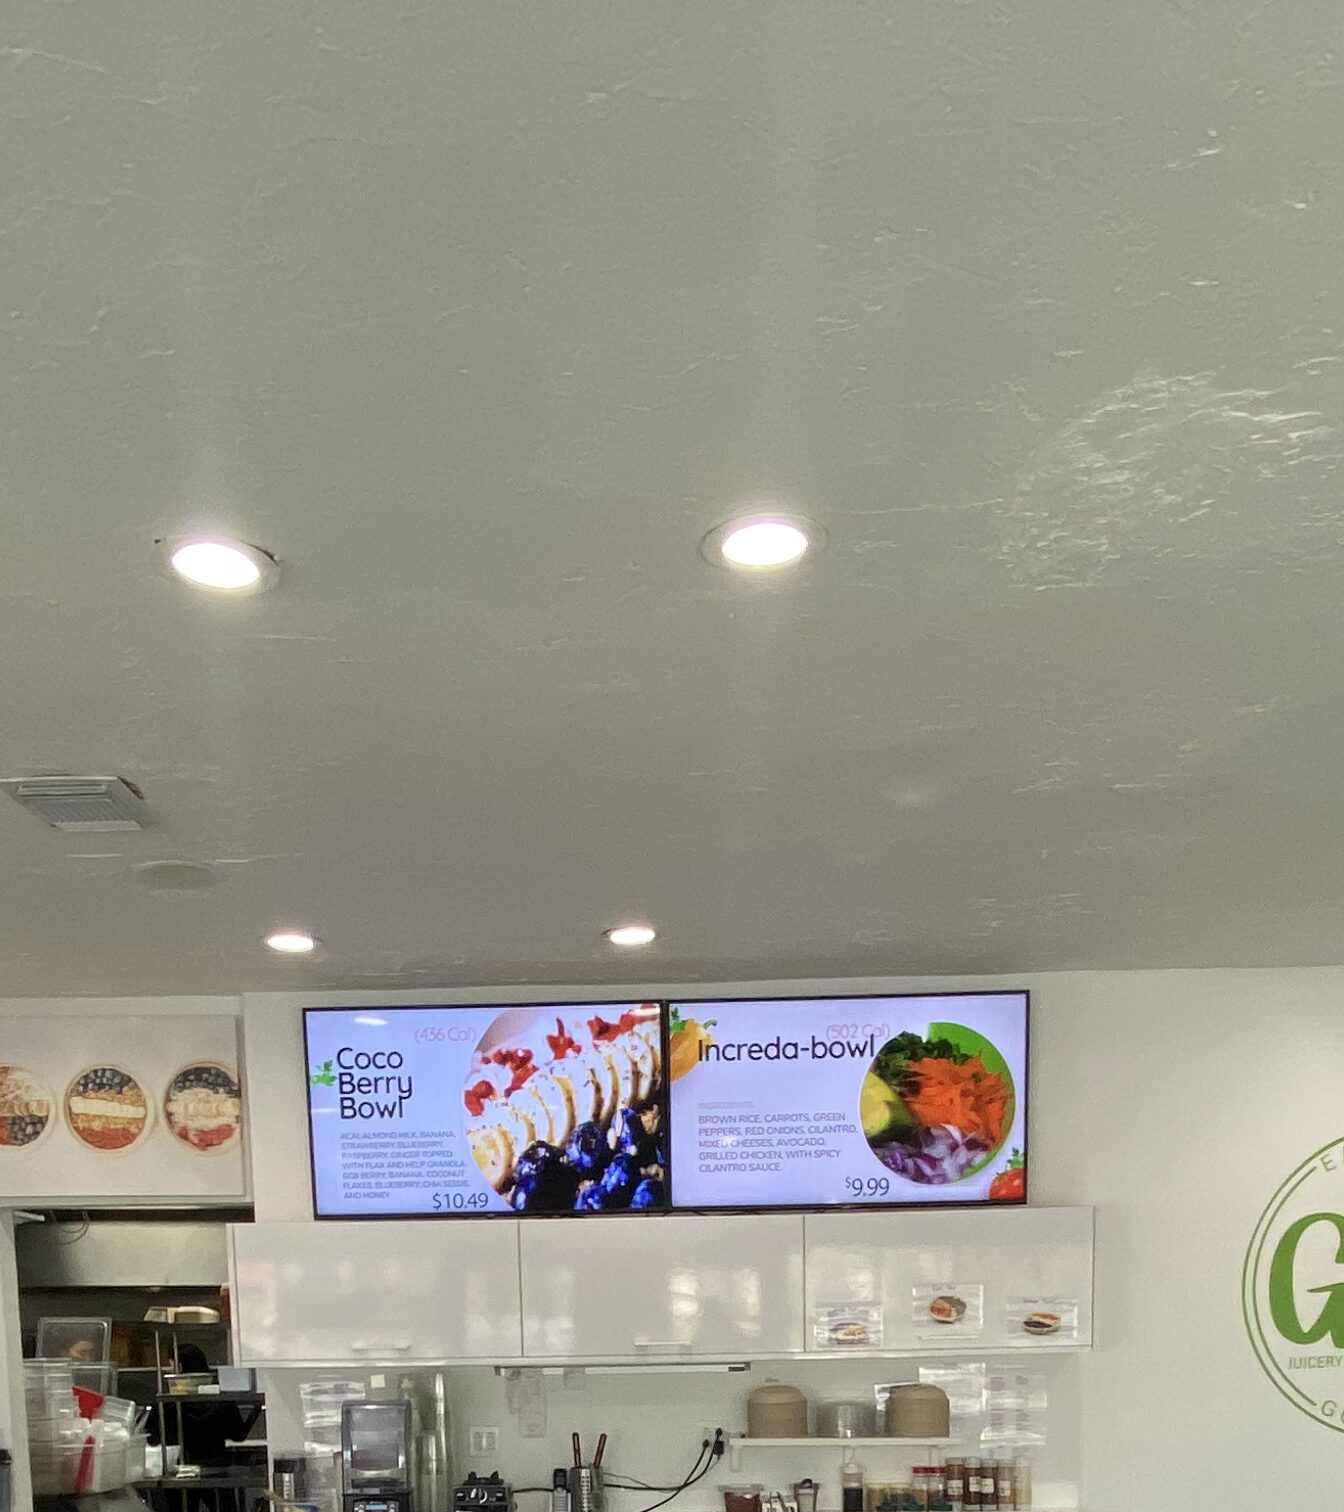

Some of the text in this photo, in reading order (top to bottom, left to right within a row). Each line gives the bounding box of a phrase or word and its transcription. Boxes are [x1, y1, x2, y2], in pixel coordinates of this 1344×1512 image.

[698, 1033, 874, 1062] Increda-bowl
[336, 1047, 403, 1070] Coco
[338, 1072, 412, 1100] Berry
[340, 1096, 404, 1119] Bowl
[698, 1115, 737, 1124] BROWN
[812, 1112, 846, 1122] GREEN
[745, 1126, 764, 1135] RED
[698, 1152, 738, 1160] GRILLED
[786, 1150, 812, 1159] WITH
[813, 1149, 842, 1158] SPICY
[698, 1164, 747, 1173] CILANTRO
[845, 1177, 890, 1197] $9.99
[432, 1192, 489, 1210] $10.49
[1288, 1354, 1343, 1370] JUICERY
